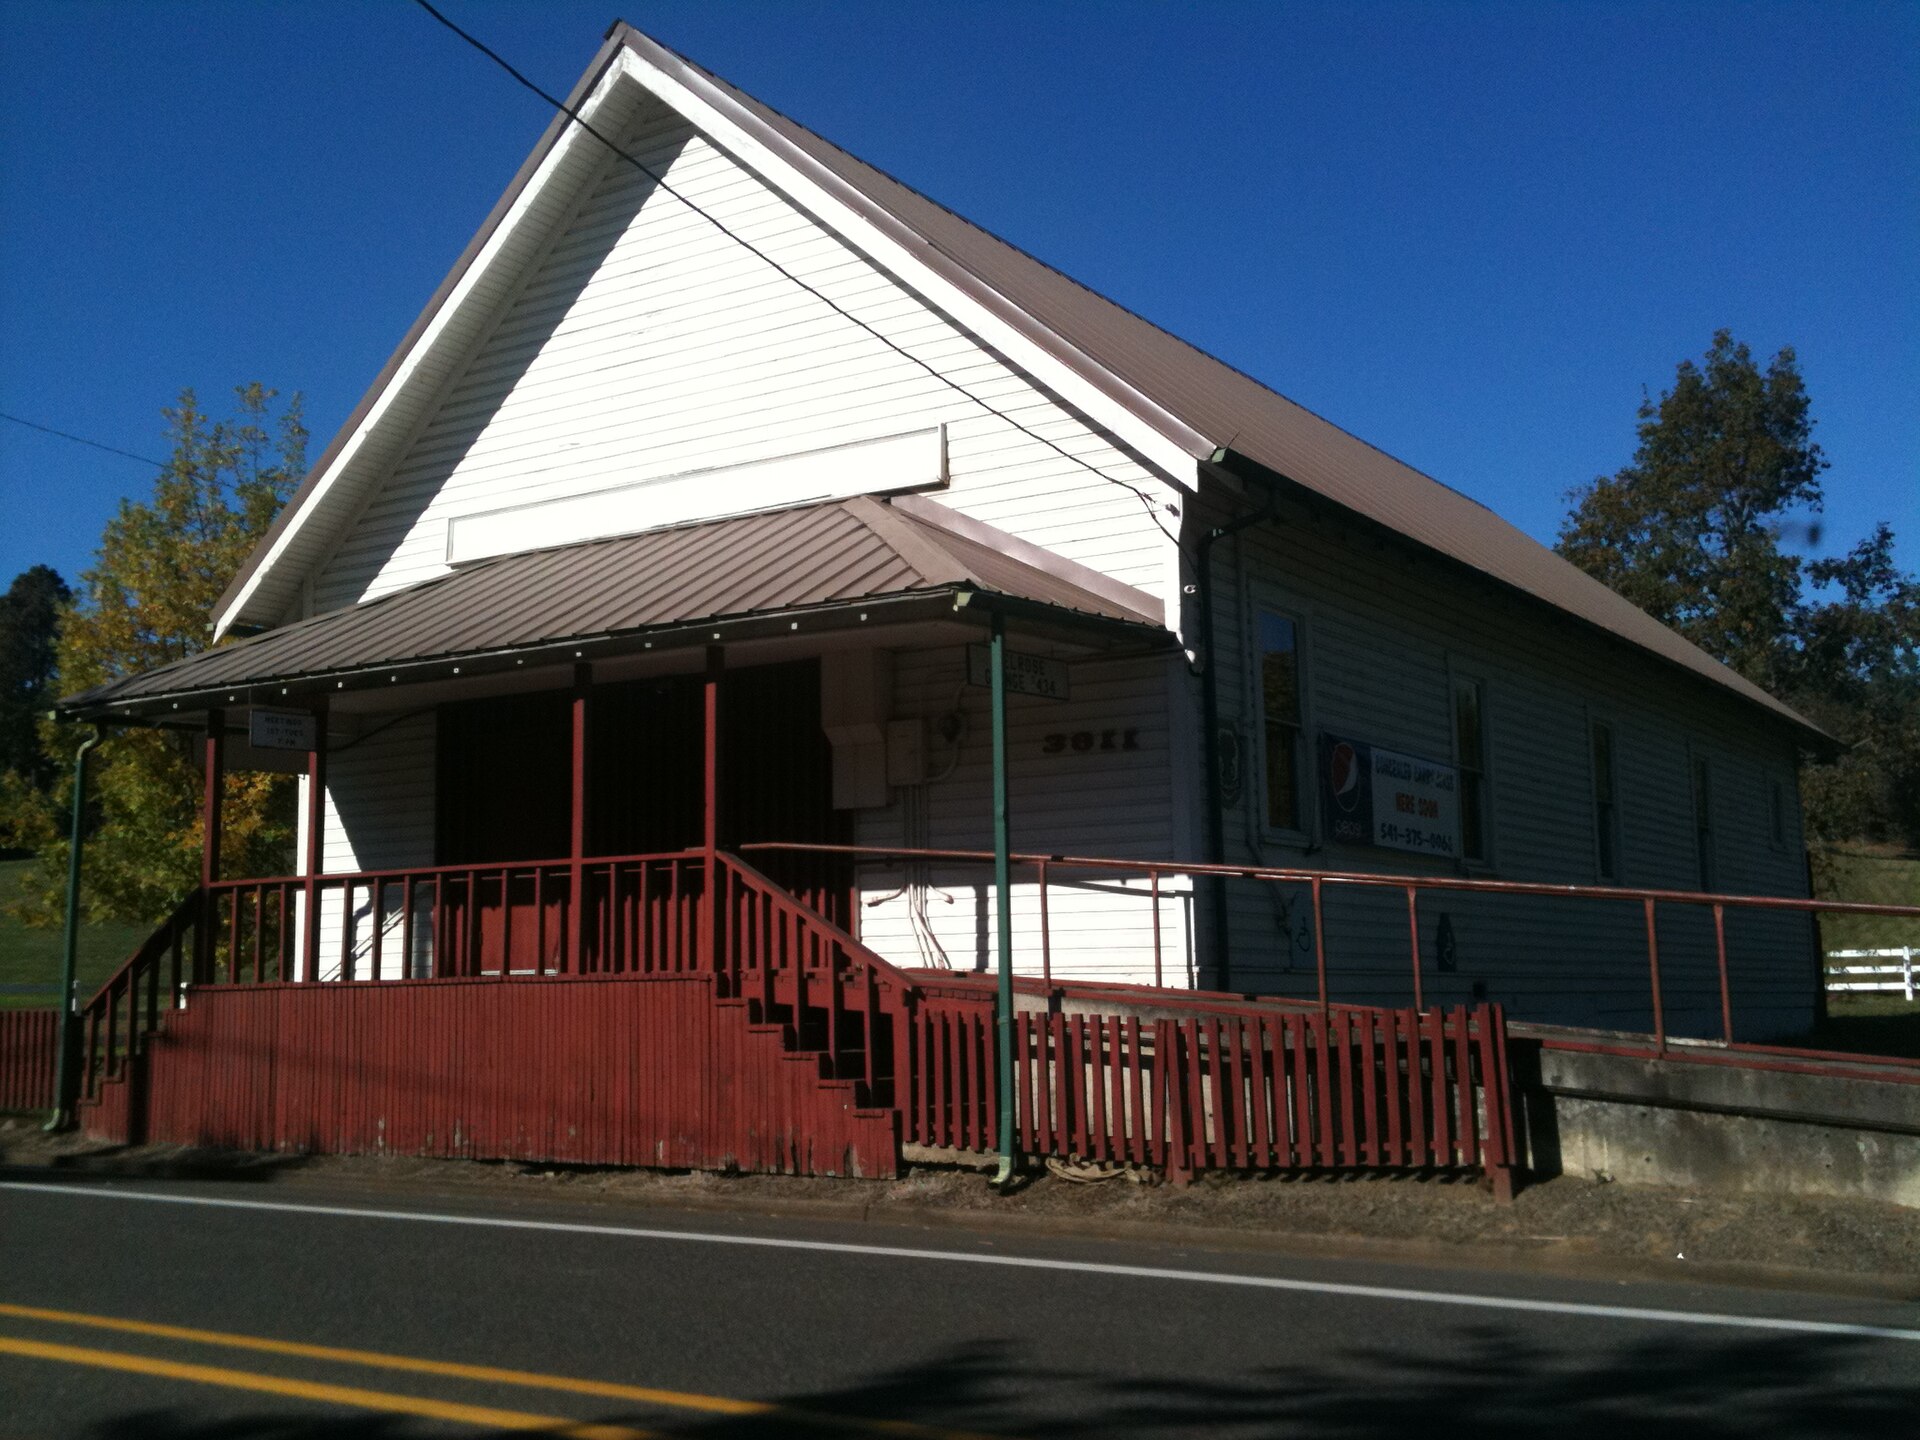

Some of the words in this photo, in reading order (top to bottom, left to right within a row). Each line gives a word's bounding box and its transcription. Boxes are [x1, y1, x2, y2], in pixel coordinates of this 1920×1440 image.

[1003, 653, 1045, 675] ELROSE
[984, 668, 1025, 690] GNGE
[1042, 728, 1140, 753] 3011
